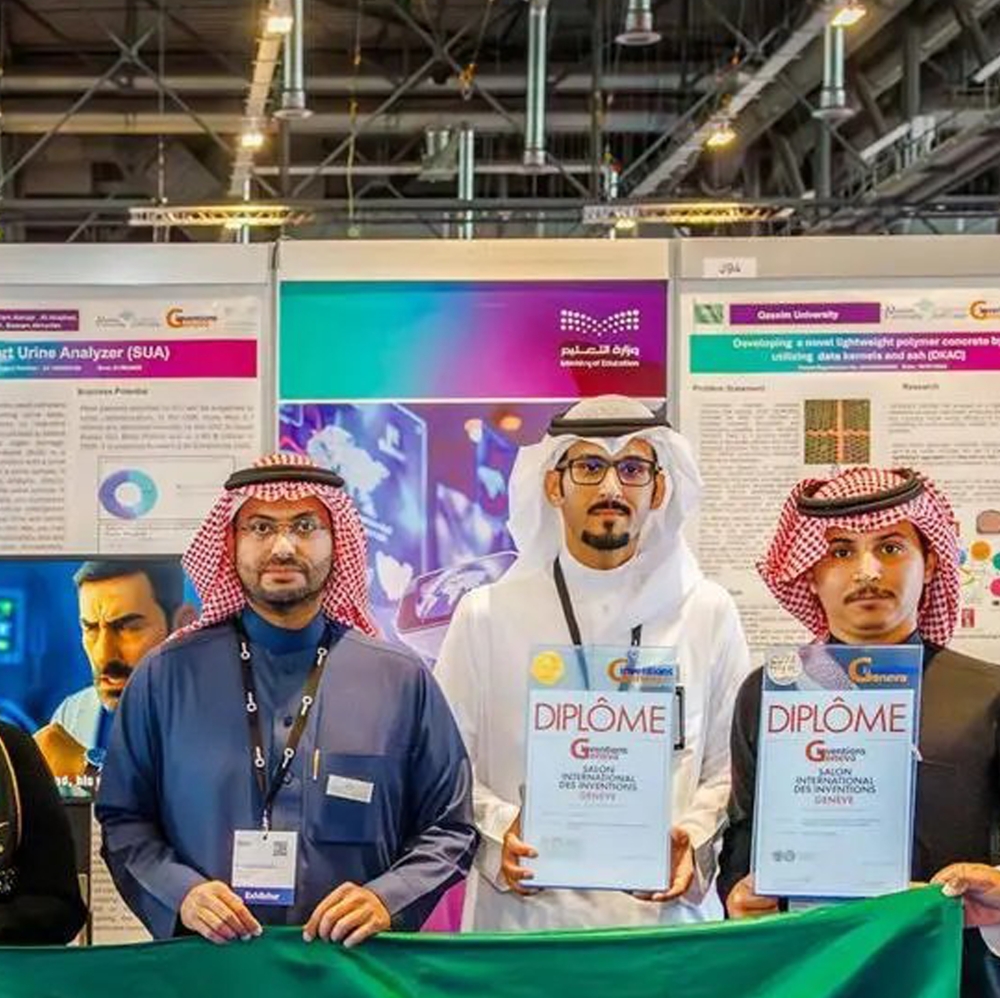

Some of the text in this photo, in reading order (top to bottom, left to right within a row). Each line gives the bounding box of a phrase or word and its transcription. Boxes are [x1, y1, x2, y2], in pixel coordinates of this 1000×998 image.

[793, 310, 839, 320] University
[733, 338, 794, 349] Developing
[805, 337, 834, 347] novel
[836, 336, 894, 348] lightweight
[896, 338, 940, 348] polymer
[941, 336, 989, 346] concrete
[17, 346, 56, 359] Urine
[60, 346, 124, 361] Analyzer
[127, 346, 170, 361] (SUA)
[771, 352, 814, 363] utilizing
[885, 351, 905, 360] and
[535, 696, 666, 734] DIPLÔME
[768, 696, 907, 733] DIPLÔME
[583, 765, 615, 773] SALON
[818, 768, 853, 776] SALON
[562, 773, 635, 783] INTERNATIONAL
[795, 777, 875, 785] INTERNATIONAL
[559, 781, 637, 792] DES INVENTIONS
[794, 785, 876, 794] DES INVENTIONS
